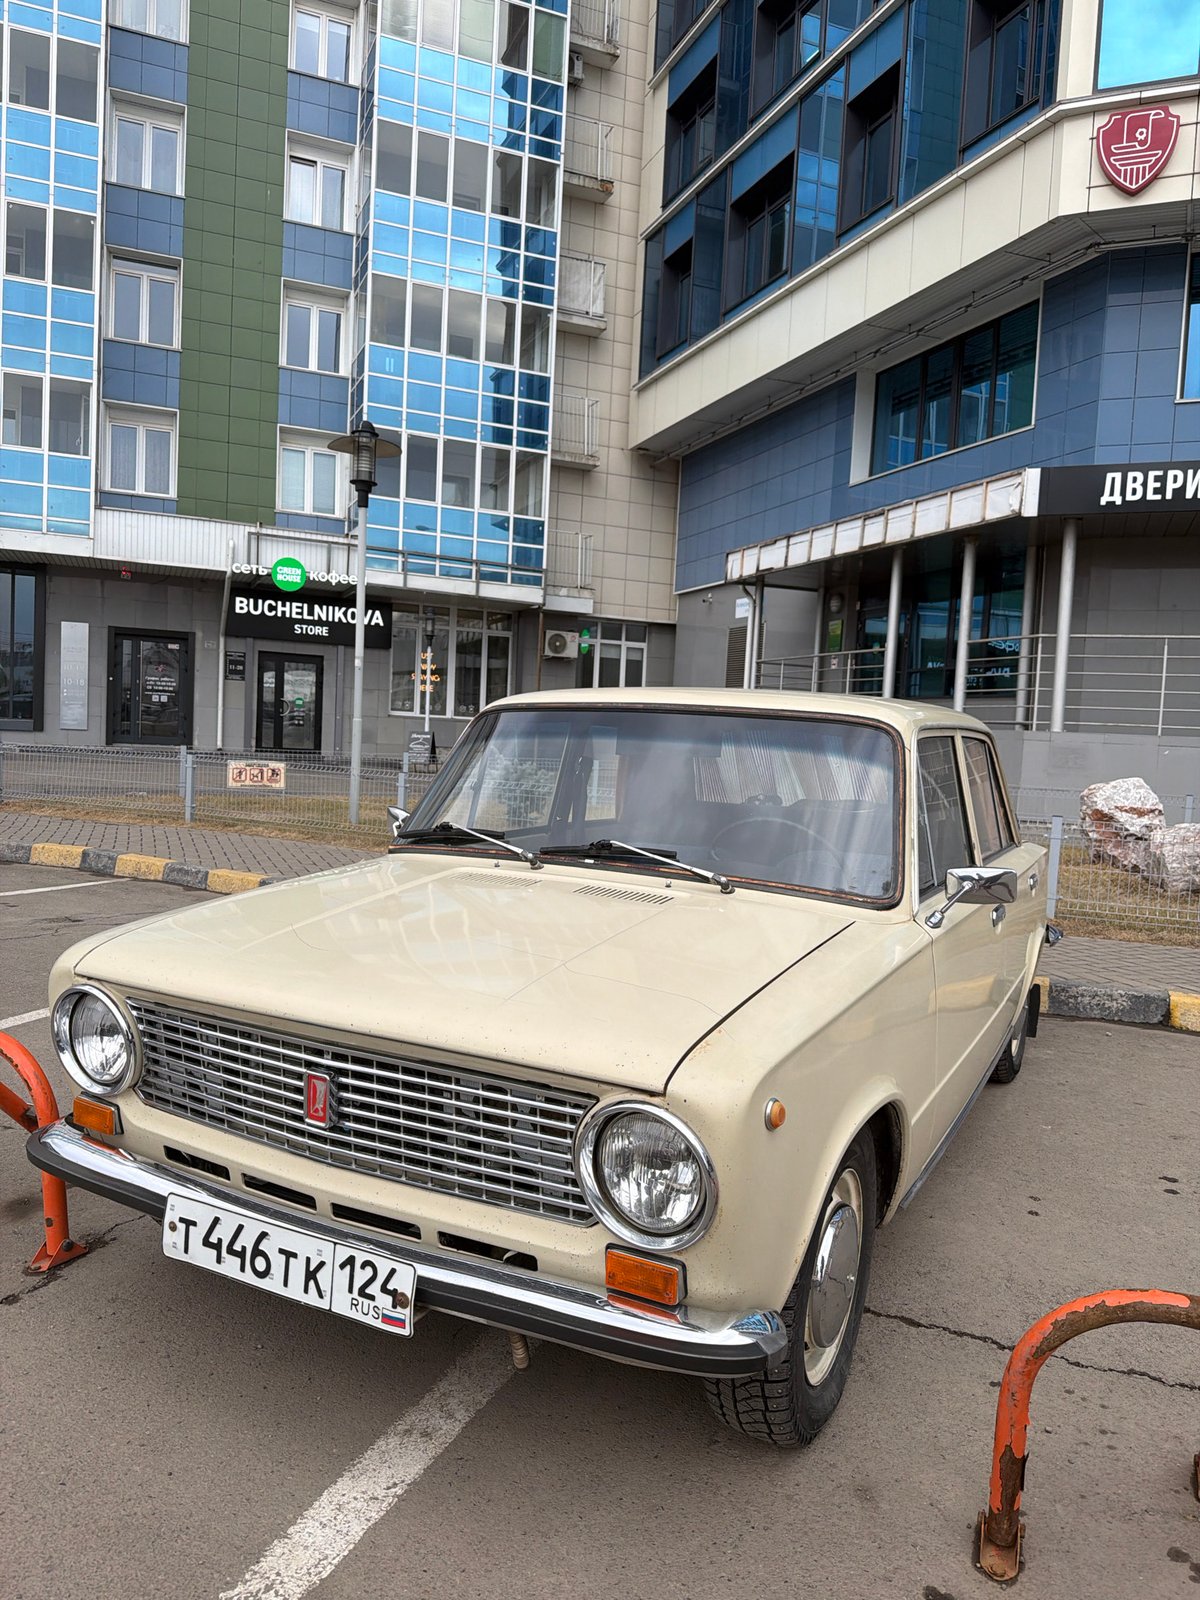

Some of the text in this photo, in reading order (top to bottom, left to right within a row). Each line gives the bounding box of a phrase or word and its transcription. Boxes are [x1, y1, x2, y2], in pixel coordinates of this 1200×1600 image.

[1100, 469, 1200, 505] ДВЕРИ
[232, 563, 268, 576] сеть
[276, 566, 302, 576] GREEN
[276, 574, 302, 583] HOUSE
[309, 569, 367, 586] кофее
[294, 624, 329, 636] STORE
[339, 1254, 399, 1309] 124
[351, 1297, 380, 1320] RUS
